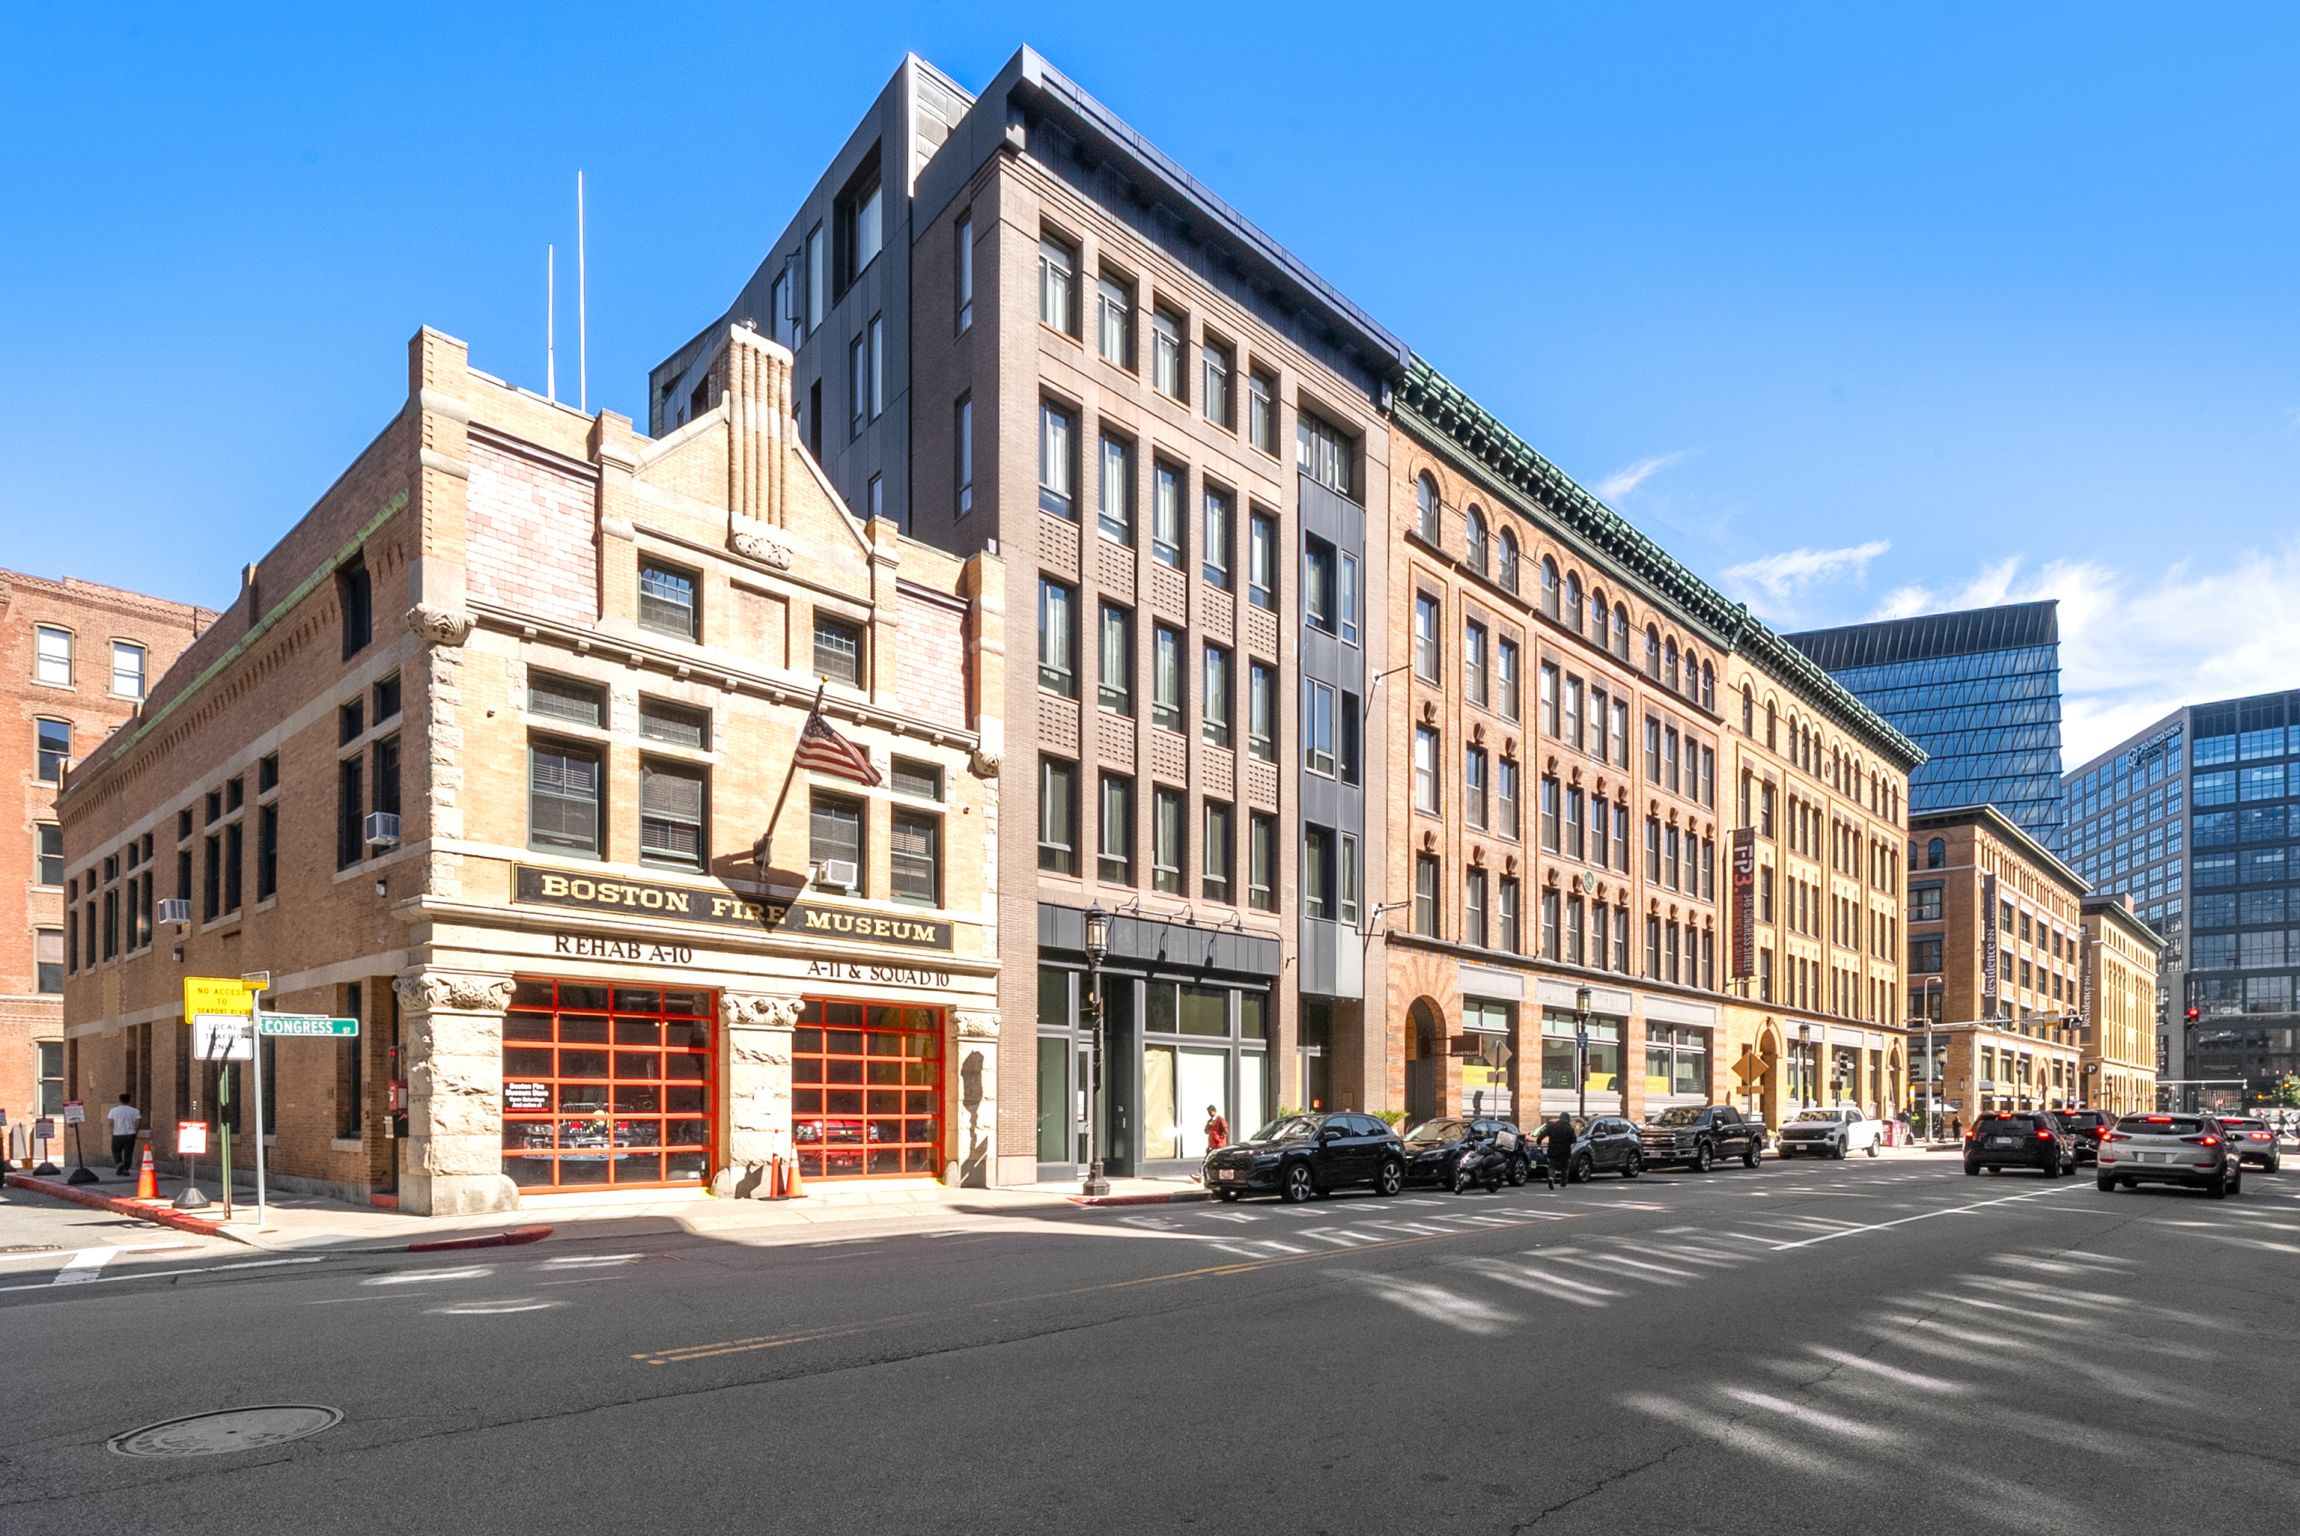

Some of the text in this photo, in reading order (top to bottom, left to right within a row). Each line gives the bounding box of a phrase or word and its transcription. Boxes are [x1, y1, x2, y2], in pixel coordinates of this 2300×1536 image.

[541, 874, 937, 943] BOSTON FIRE MUSEUM
[1743, 908, 1754, 946] CONGRESS
[554, 932, 692, 964] REHAB A-10
[1743, 947, 1754, 972] STREET
[807, 960, 950, 988] A-11 & SQUAD 10
[1985, 943, 1996, 998] Residence
[197, 987, 209, 995] NO
[217, 998, 228, 1006] TO
[208, 1023, 239, 1031] LOCAL
[264, 1020, 352, 1034] CONGRESS ST
